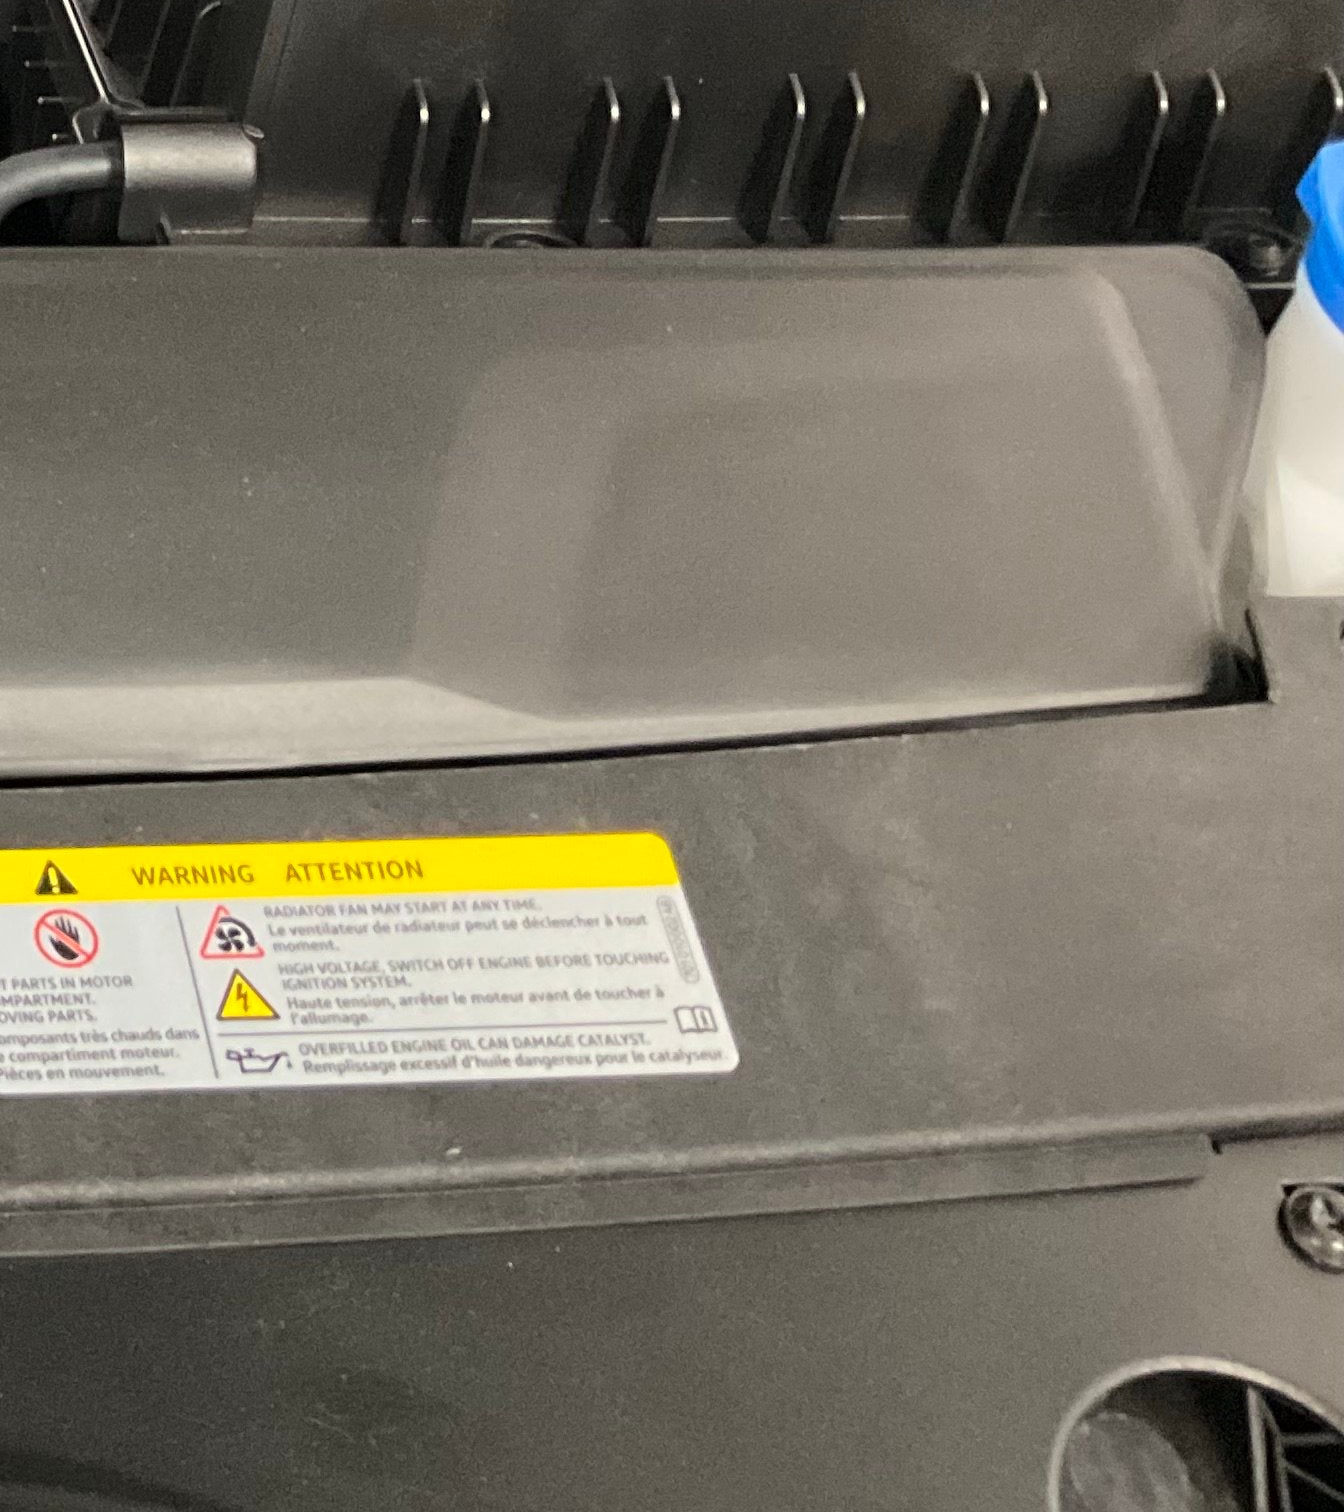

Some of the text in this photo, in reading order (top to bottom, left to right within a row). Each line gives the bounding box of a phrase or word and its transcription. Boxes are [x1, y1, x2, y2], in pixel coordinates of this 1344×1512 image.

[131, 859, 425, 887] WARNING ATTENTION
[264, 900, 499, 918] RADIATOR FAN MAY START AT ANY
[268, 924, 285, 937] Le
[289, 922, 367, 936] ventilateur
[373, 921, 391, 934] de
[395, 920, 460, 933] radiateur
[466, 919, 498, 933] peut
[502, 920, 518, 930] se
[617, 914, 647, 927] tout
[279, 951, 669, 975] HIGH SWITCH OFF ENGINE BEFORE TOUCHING
[12, 977, 56, 990] PARTS
[61, 977, 75, 988] IN
[81, 975, 133, 989] MOTOR
[282, 977, 347, 991] IGNITION
[287, 997, 332, 1010] Haute
[453, 992, 468, 1005] le
[471, 991, 524, 1004] moteur
[529, 990, 570, 1002] avant
[574, 988, 592, 1001] de
[595, 986, 651, 1000] toucher
[111, 1028, 162, 1042] chauds
[166, 1027, 200, 1040] dans
[299, 1035, 575, 1056] OVERFILLED ENGINE OIL CAN DAMAGE
[9, 1048, 116, 1064] compartiment
[303, 1060, 396, 1076] Remplissage
[516, 1054, 591, 1069] dangereux
[596, 1053, 627, 1067] pour
[632, 1050, 646, 1062] le
[47, 1068, 65, 1079] en
